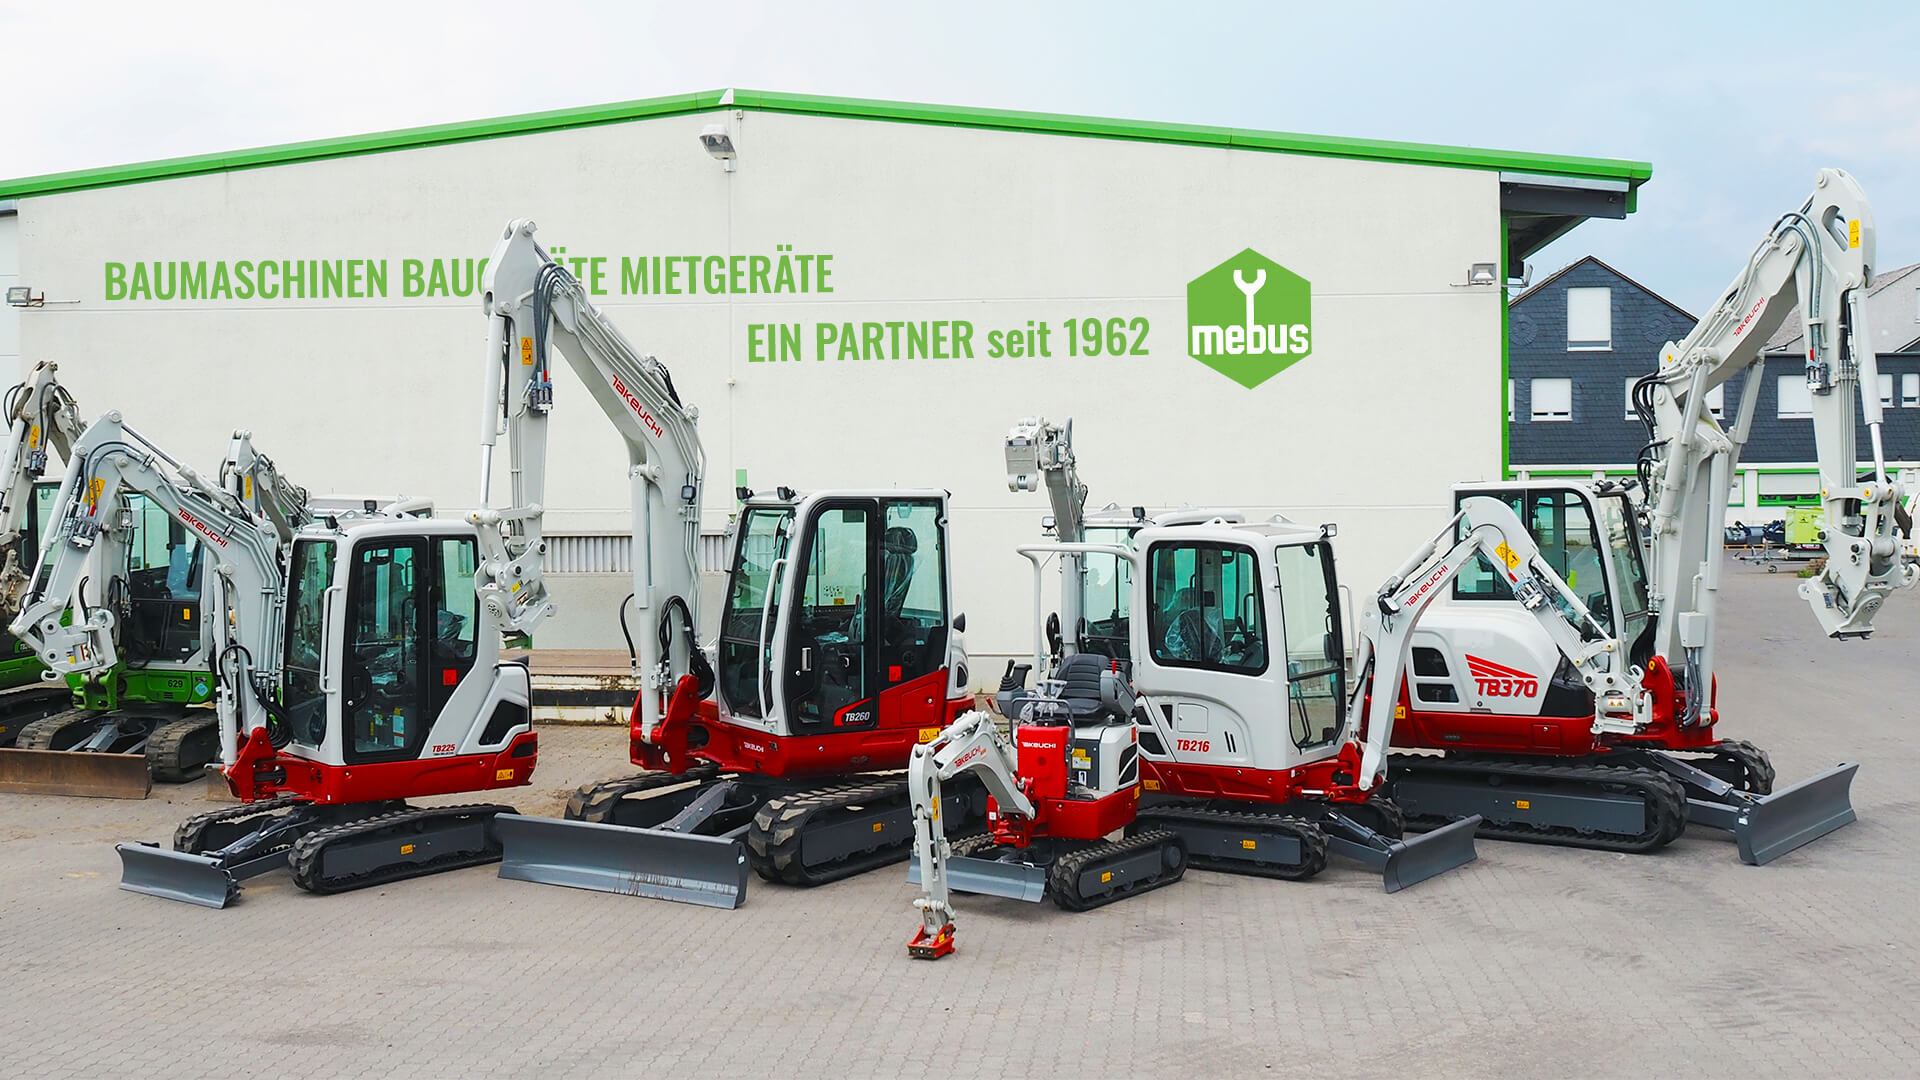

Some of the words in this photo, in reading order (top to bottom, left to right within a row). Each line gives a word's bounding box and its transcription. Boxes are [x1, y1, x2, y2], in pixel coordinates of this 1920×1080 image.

[105, 259, 388, 301] BAUMASCHINEN
[402, 247, 608, 298] BAUTE
[621, 244, 834, 295] MIETGERÄTE
[747, 323, 802, 363] EIN
[815, 320, 975, 361] PARTNER
[987, 320, 1052, 359] seit
[1063, 316, 1150, 357] 1962
[1191, 323, 1309, 355] mebus
[612, 374, 664, 439] TAKEUCHI
[177, 507, 229, 548] TAKEUCHI
[1403, 564, 1449, 607] TAKEUCHI
[167, 679, 184, 688] 629
[1474, 678, 1539, 698] TB370
[845, 711, 871, 722] TB260
[432, 744, 456, 753] TB225
[1021, 741, 1056, 749] TAKEUCHI
[1177, 739, 1210, 753] TB216
